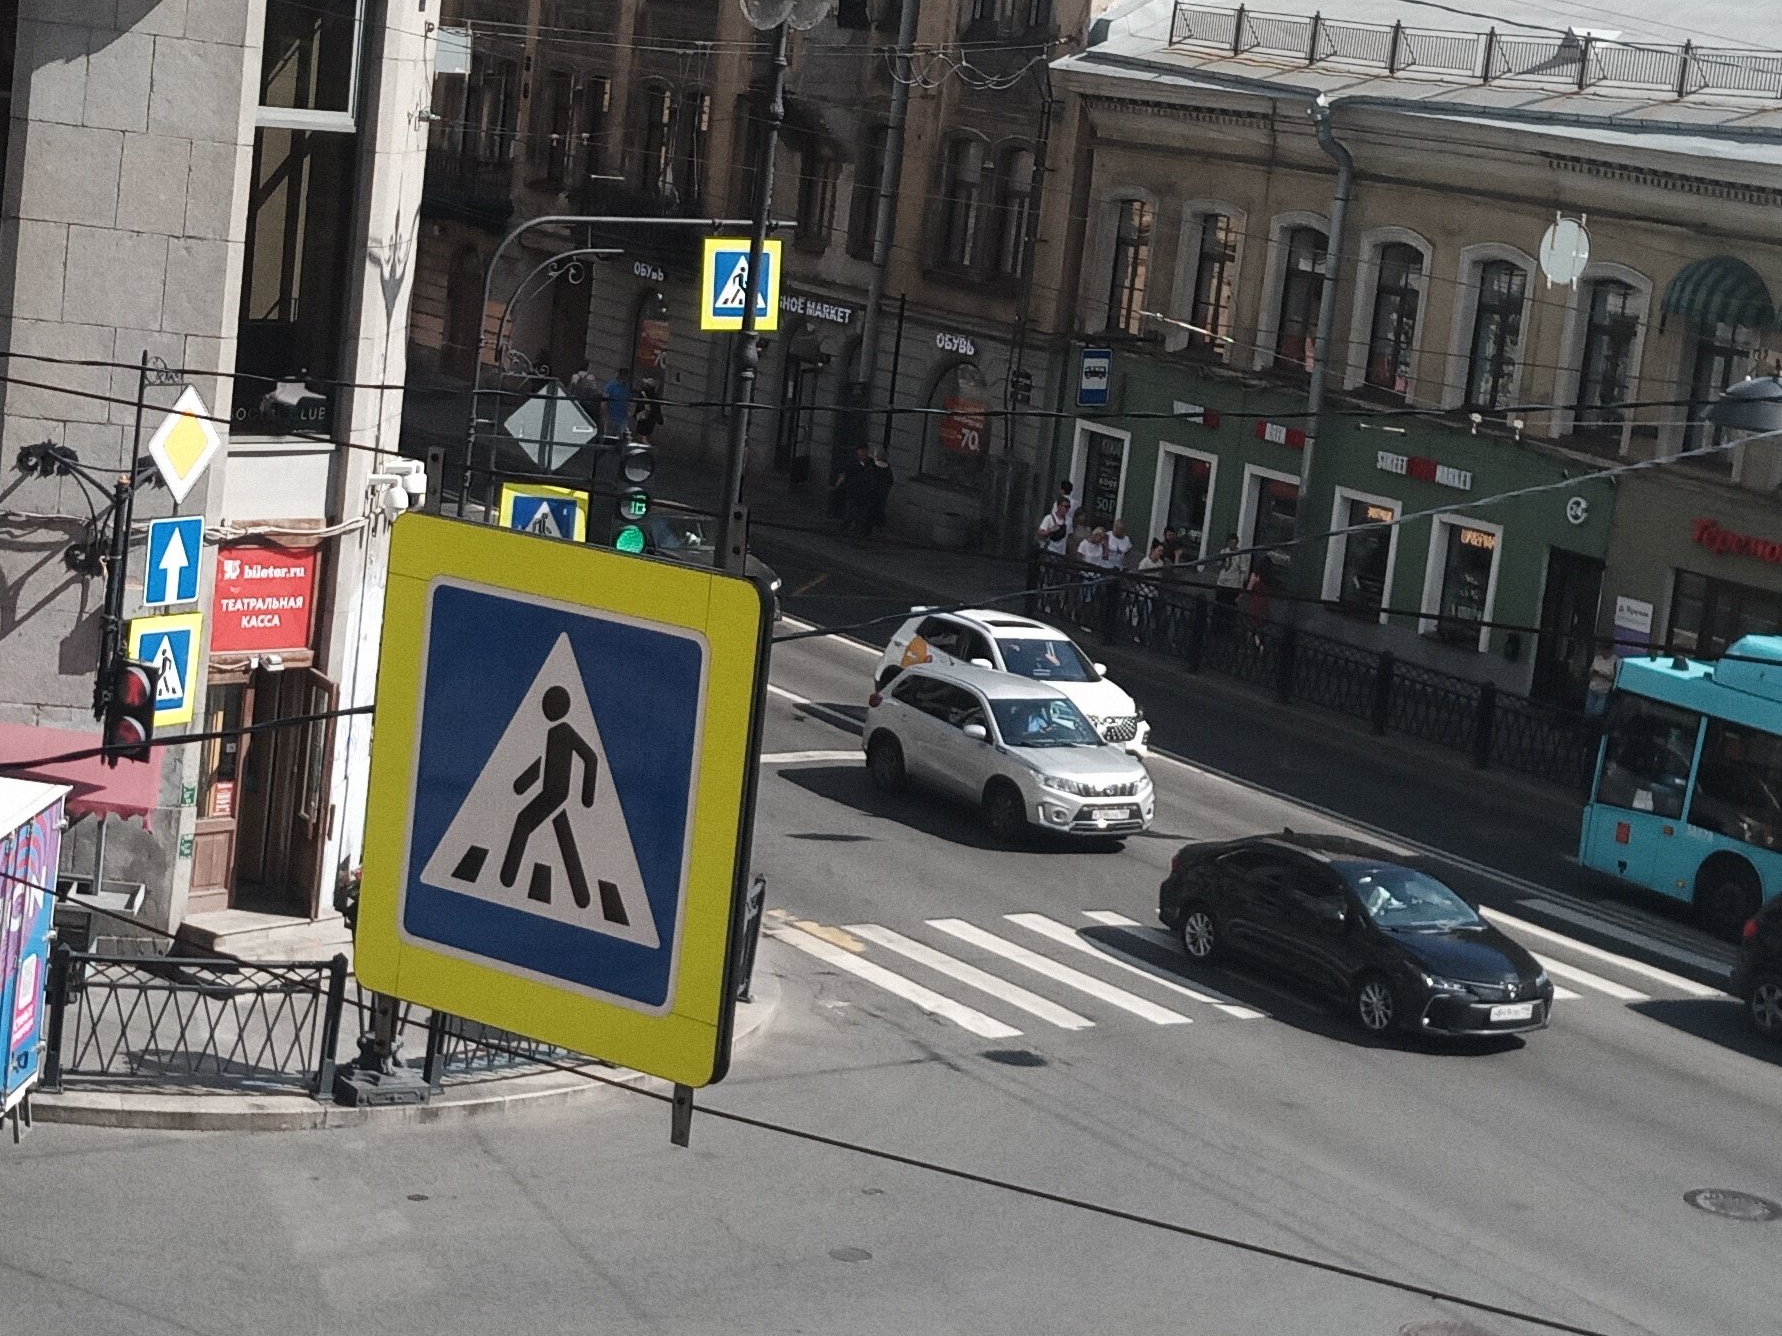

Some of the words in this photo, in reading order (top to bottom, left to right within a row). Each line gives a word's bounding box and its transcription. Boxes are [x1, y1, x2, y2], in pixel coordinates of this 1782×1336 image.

[806, 300, 852, 324] MARKET
[936, 332, 975, 356] ОБУВЬ
[244, 564, 305, 579] bileter.ru
[221, 596, 304, 612] ТЕАТРАЛЬНАЯ
[241, 614, 281, 629] КАССА
